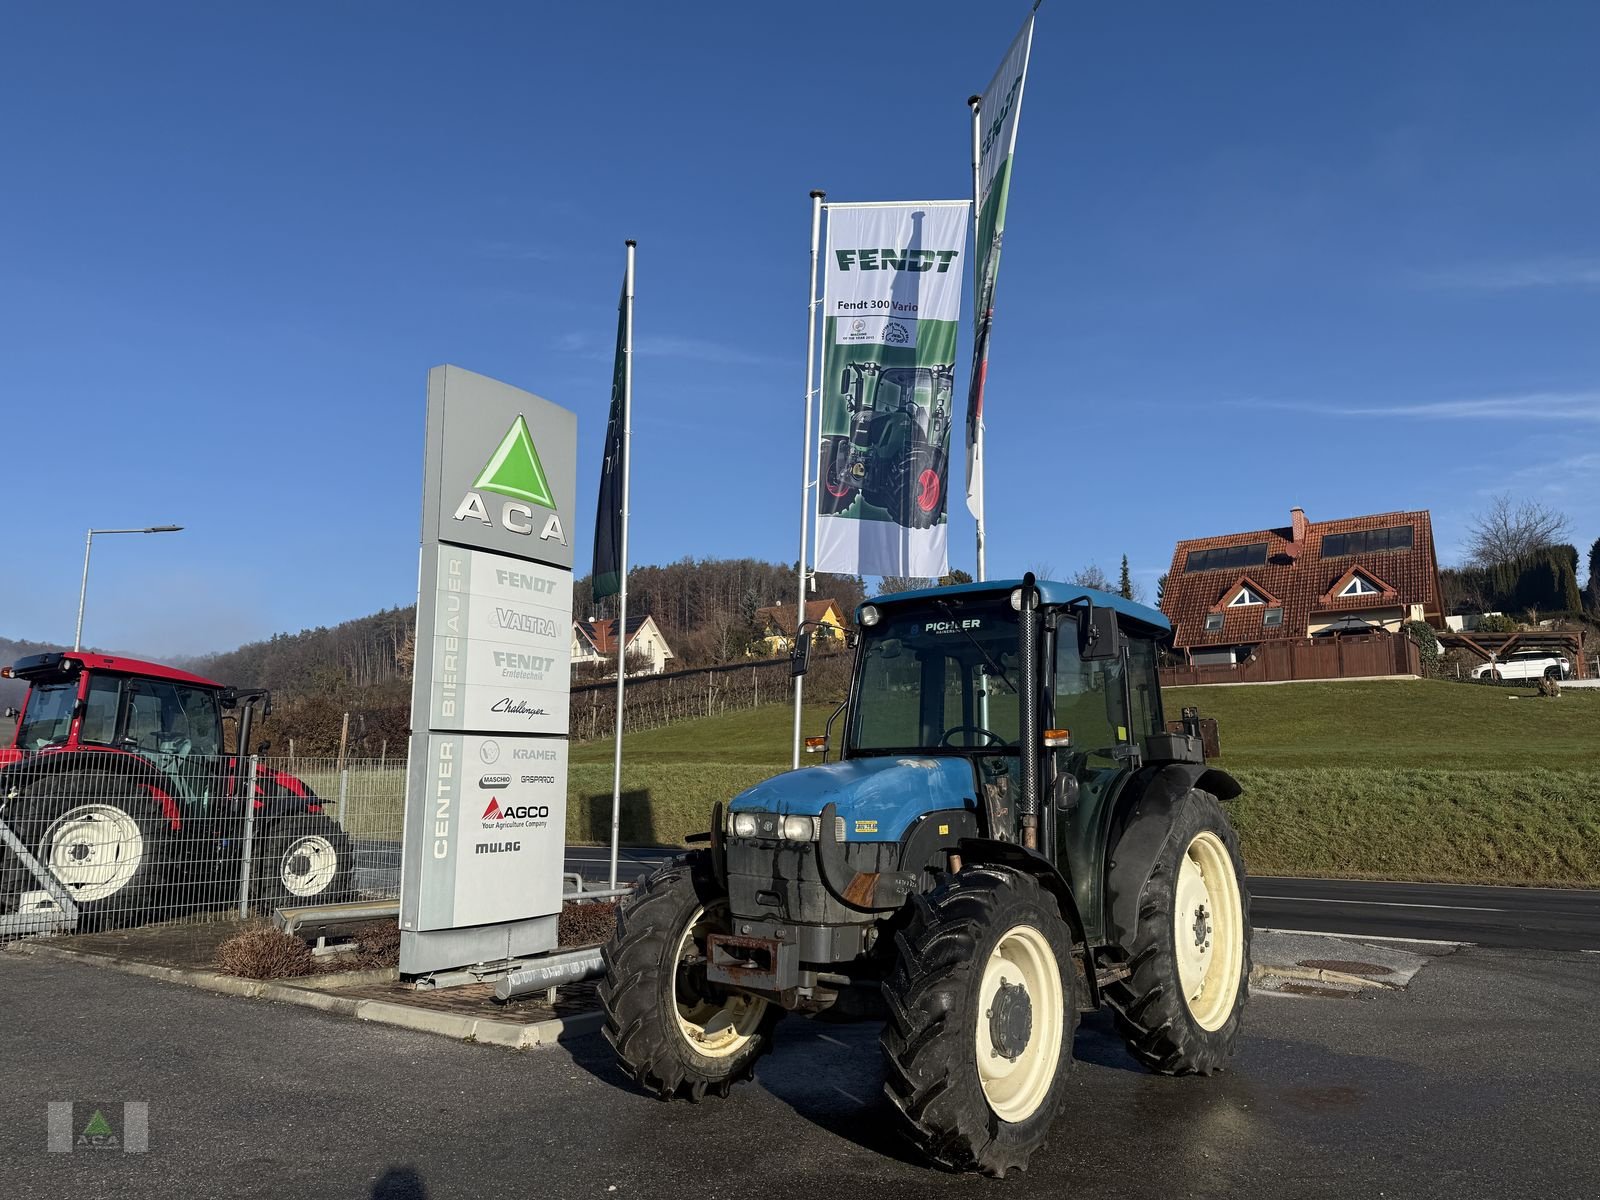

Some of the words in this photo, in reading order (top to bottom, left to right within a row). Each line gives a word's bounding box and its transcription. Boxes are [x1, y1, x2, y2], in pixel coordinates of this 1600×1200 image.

[836, 249, 959, 273] FENDT
[837, 300, 868, 310] Fendt
[870, 300, 890, 309] 300
[892, 302, 919, 312] Vario
[452, 491, 568, 546] ACA
[496, 569, 557, 595] FENDT
[496, 607, 557, 637] VALTRA
[441, 559, 463, 718] BIERBAUER
[493, 650, 555, 672] FENDT
[502, 668, 544, 681] Erntetechnik
[490, 697, 551, 720] Challenger
[513, 749, 557, 760] KRAMER
[520, 775, 555, 784] GASPARDO
[433, 741, 454, 860] CENTER
[503, 806, 549, 819] AGCO
[495, 820, 524, 831] Agriculture
[525, 820, 547, 829] Company
[475, 841, 521, 854] MULAG
